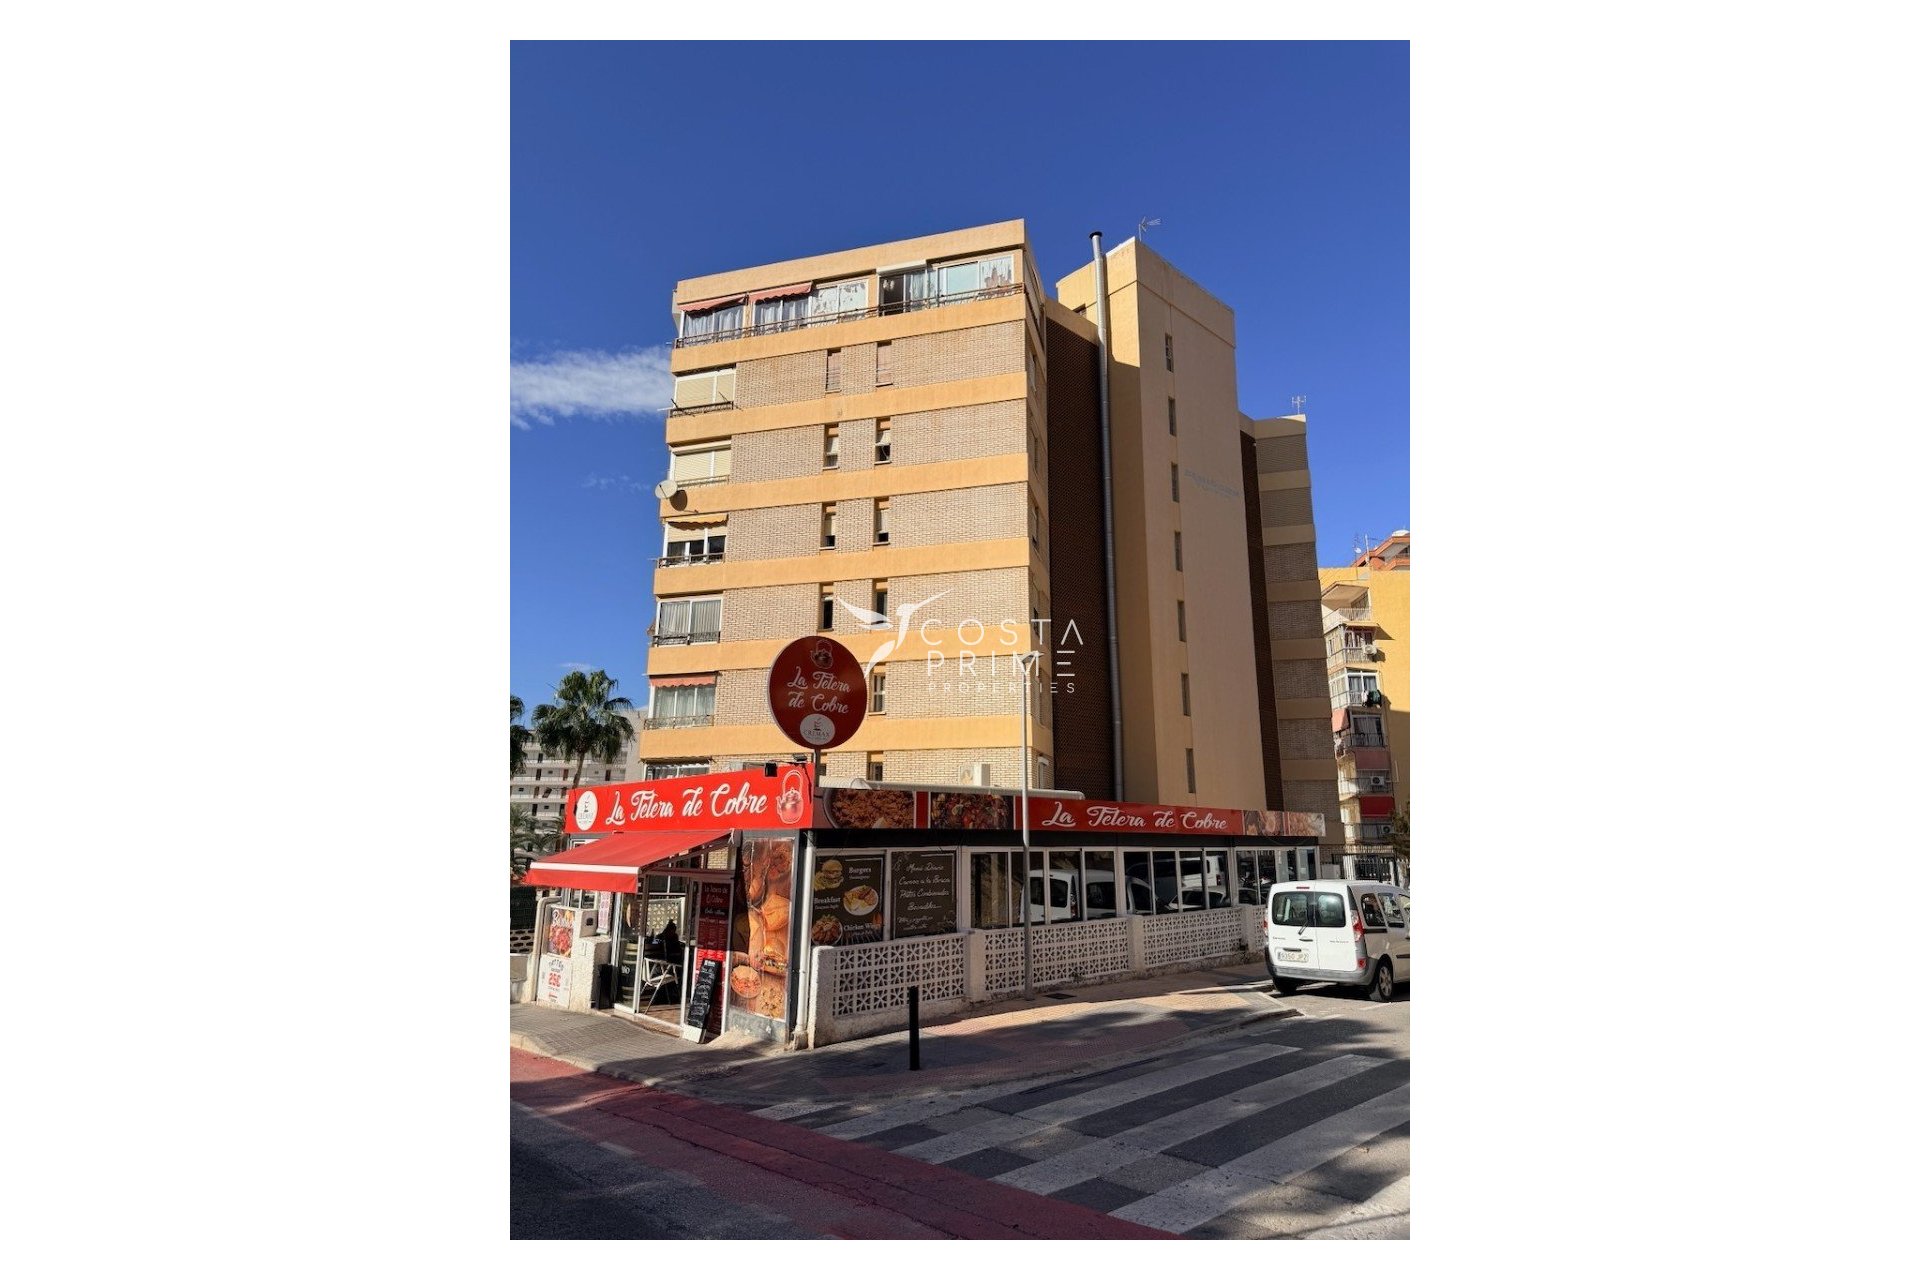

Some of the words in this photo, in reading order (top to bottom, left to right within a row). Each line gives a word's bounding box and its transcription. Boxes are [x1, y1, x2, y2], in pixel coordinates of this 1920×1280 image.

[787, 666, 808, 690] La
[812, 671, 851, 693] Tetera
[788, 691, 806, 708] de
[810, 693, 849, 714] Cobre
[605, 790, 626, 826] La
[630, 789, 675, 822] Tetera
[682, 786, 704, 817] de
[710, 781, 768, 818] Cobre
[1042, 801, 1077, 828] La
[1086, 805, 1147, 828] Tetera
[1153, 810, 1176, 829] de
[1180, 811, 1228, 830] Cobre
[848, 867, 872, 875] Burgers
